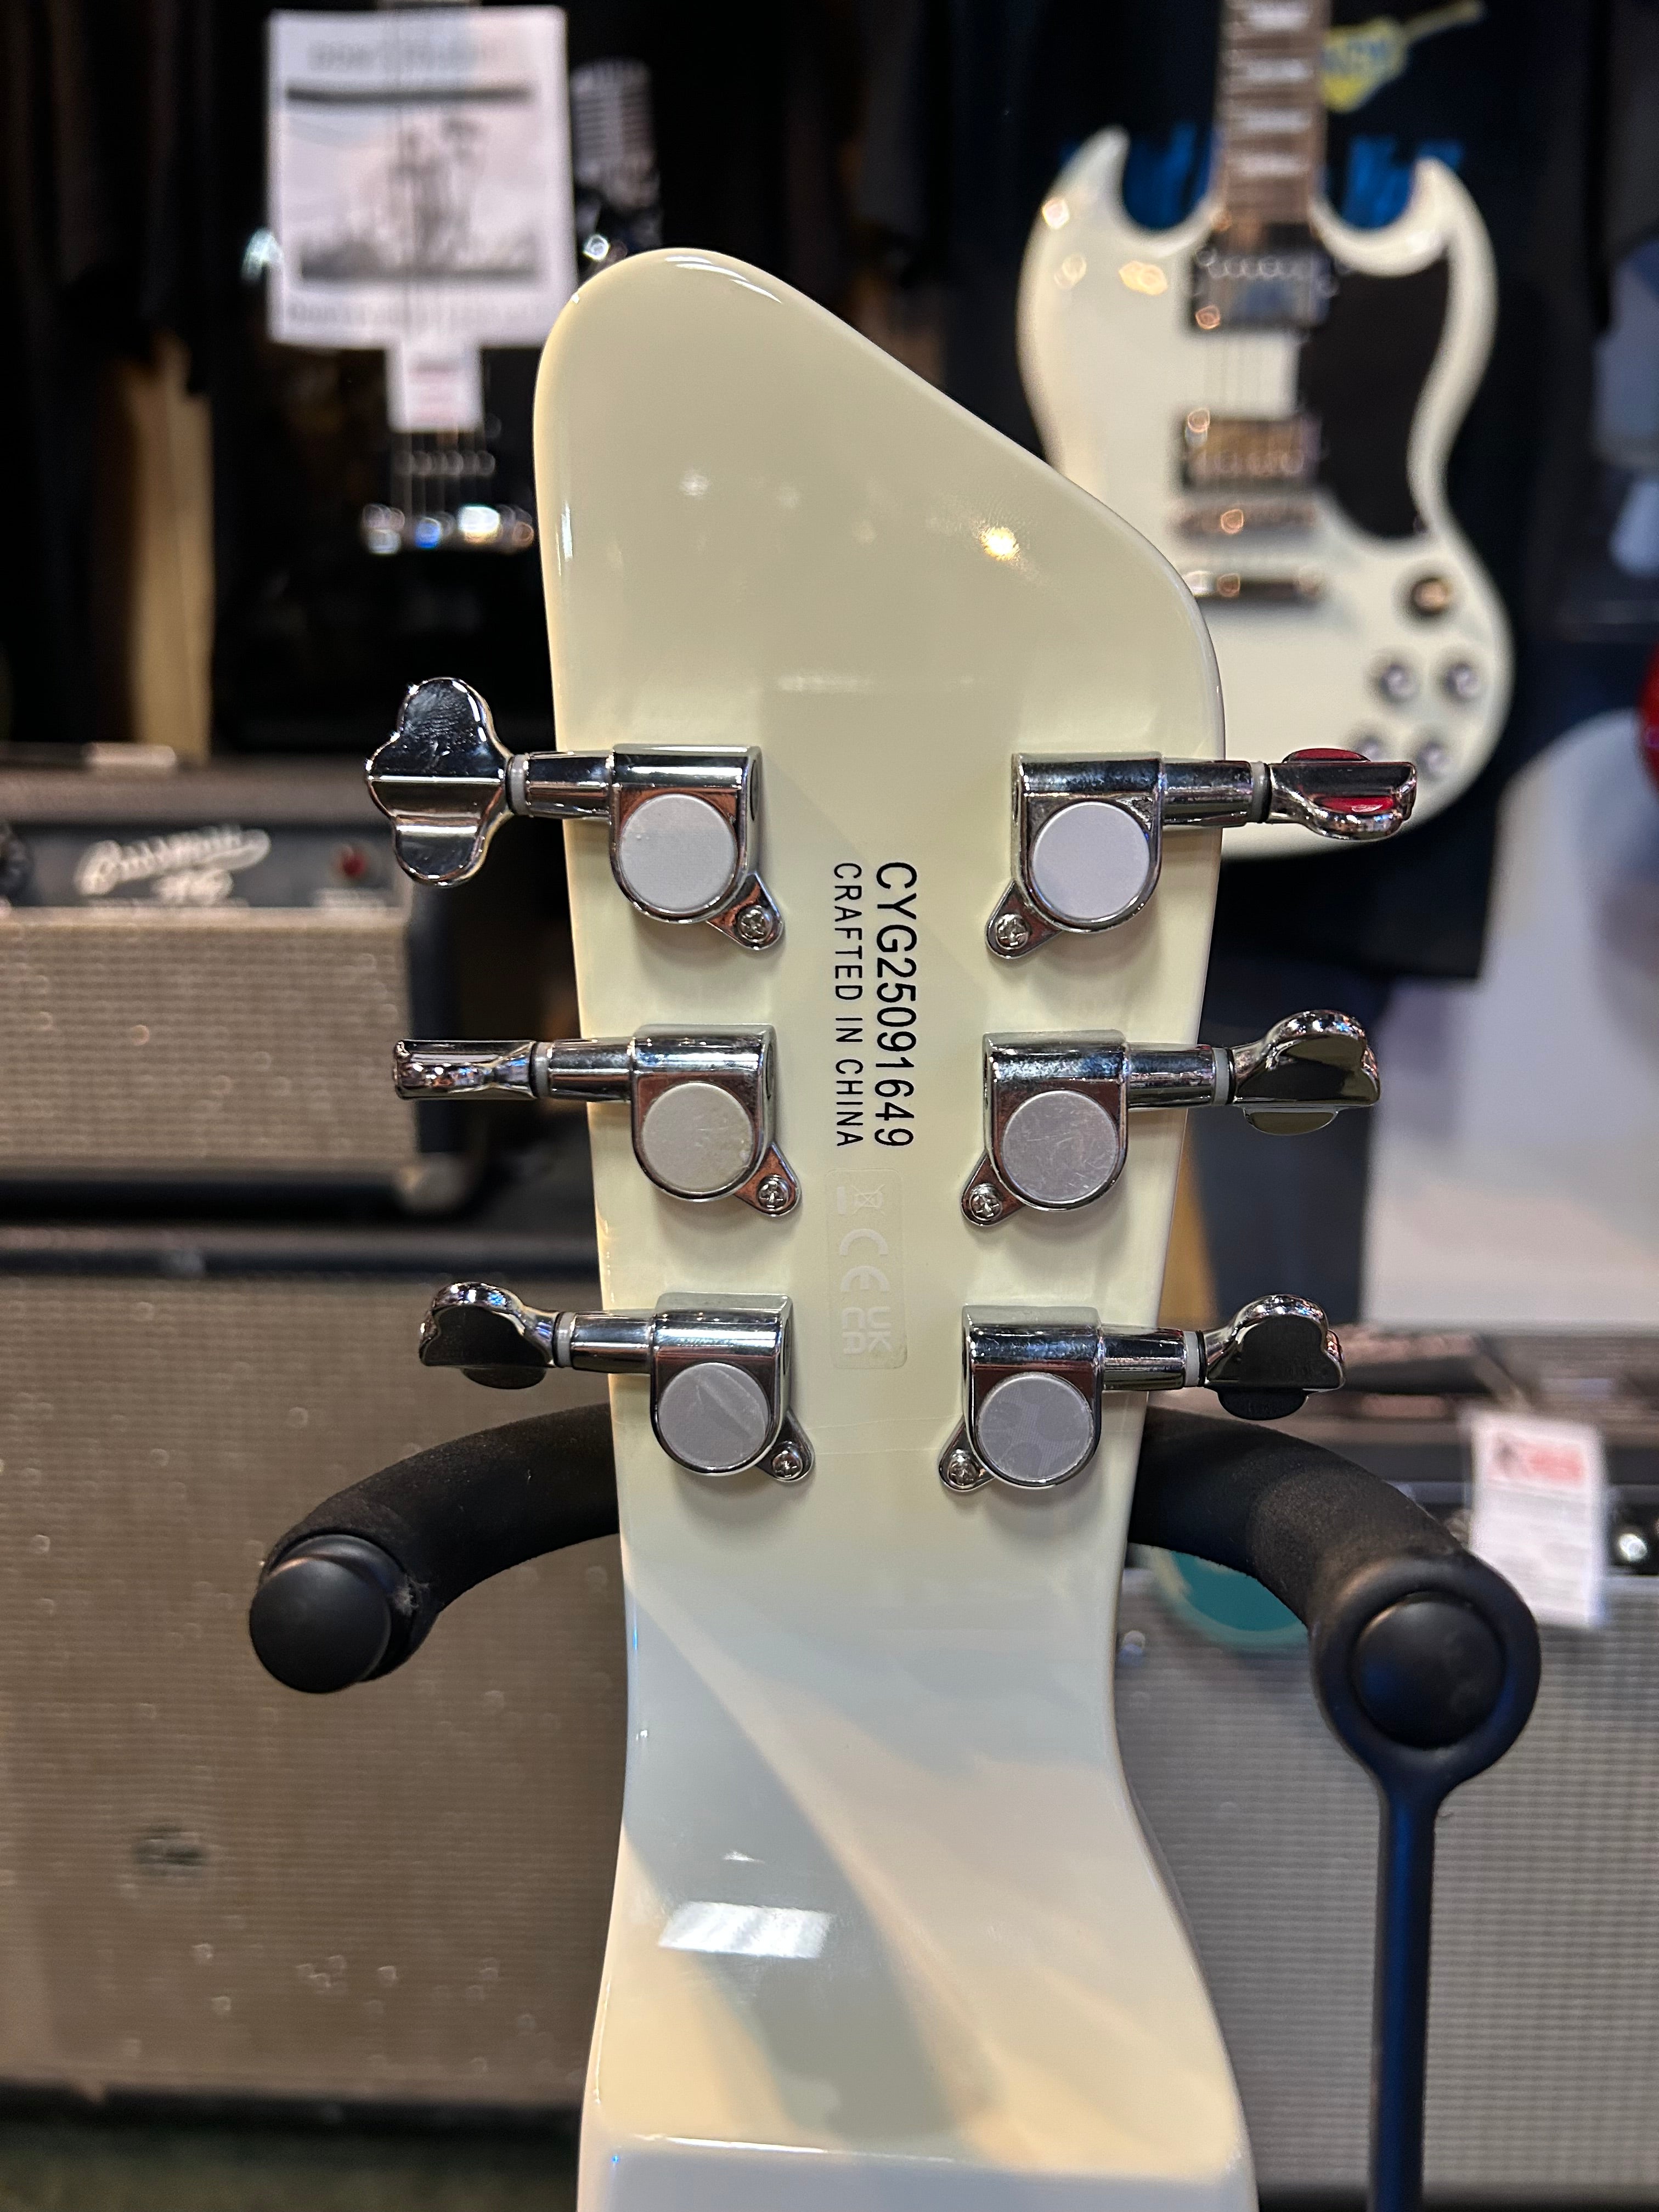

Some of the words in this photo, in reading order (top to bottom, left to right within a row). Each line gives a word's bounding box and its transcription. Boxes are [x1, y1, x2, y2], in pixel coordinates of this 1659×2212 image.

[834, 863, 863, 1000] CRAFTED
[836, 1018, 863, 1042] IN
[874, 862, 917, 1146] CYG25091649
[836, 1059, 864, 1147] CHINA
